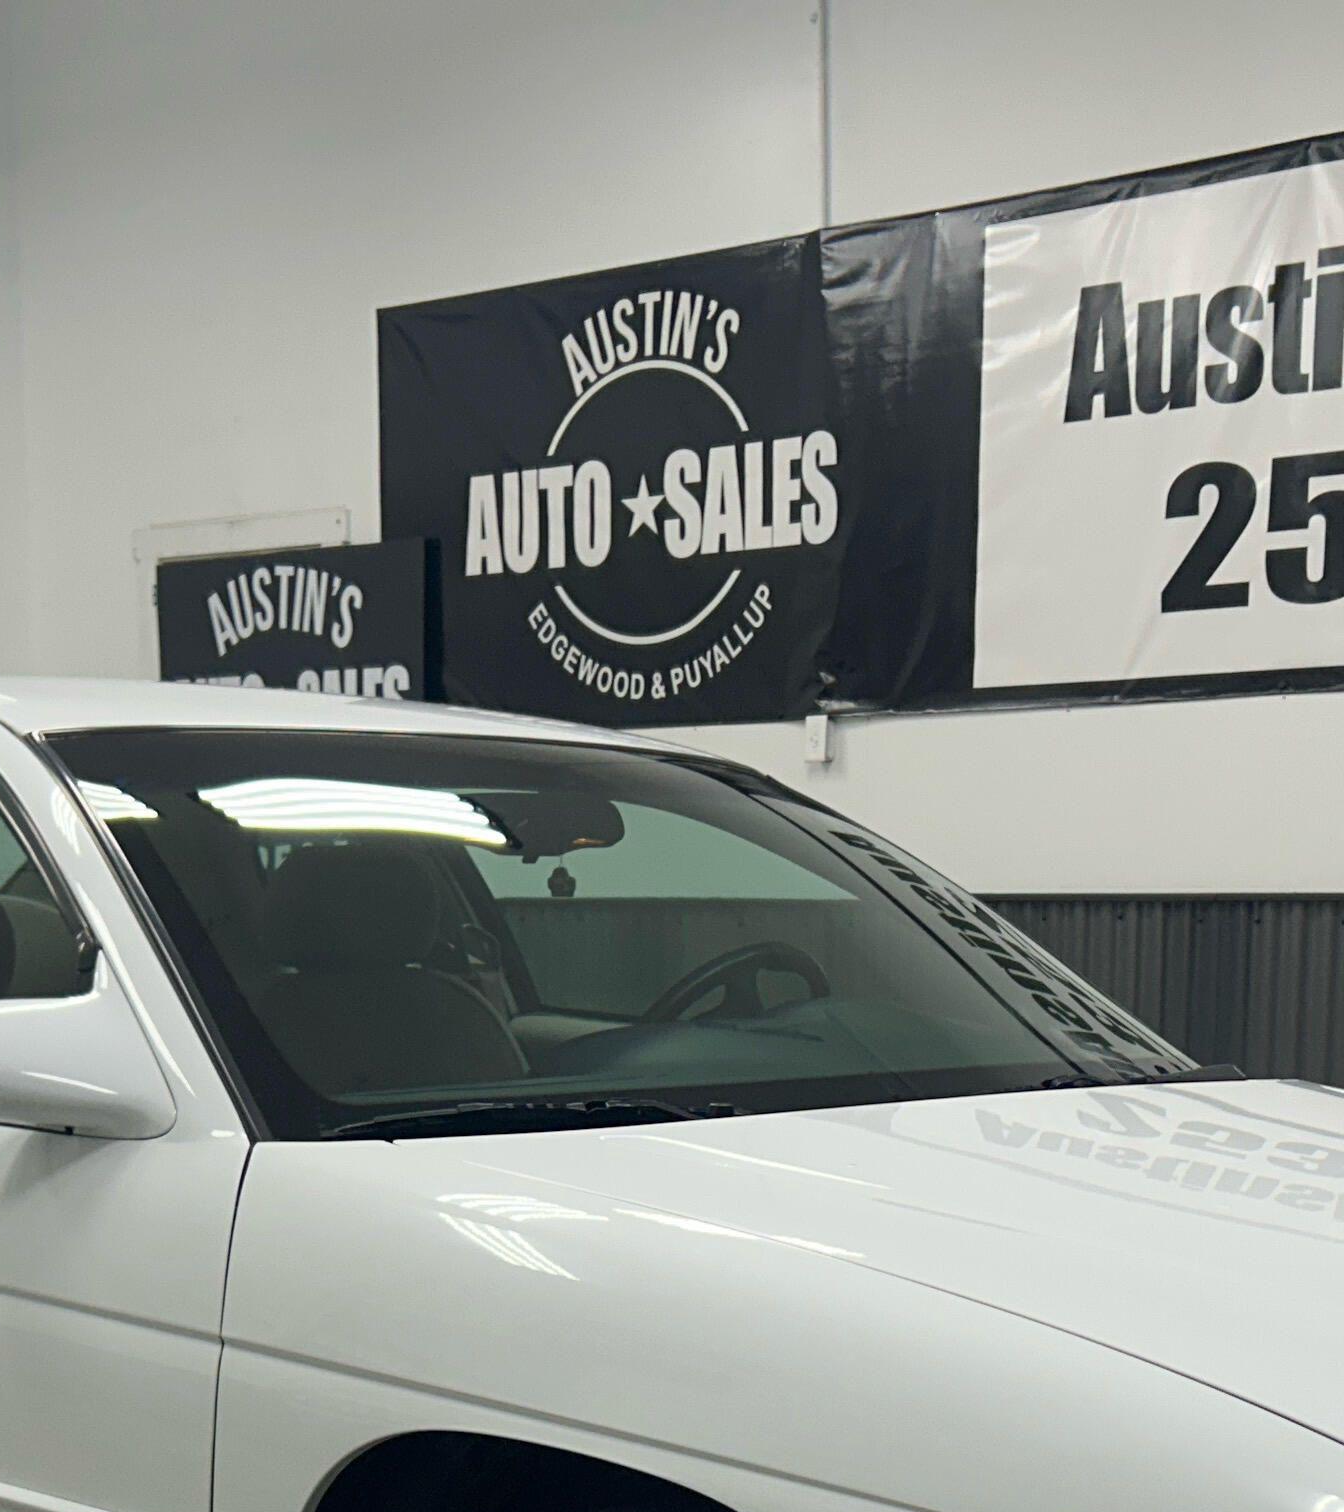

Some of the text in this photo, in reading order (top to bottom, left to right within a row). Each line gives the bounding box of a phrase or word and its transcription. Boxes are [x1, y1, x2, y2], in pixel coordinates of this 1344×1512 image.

[561, 289, 741, 397] AUSTIN'S
[465, 429, 840, 577] AUTO SALES
[206, 563, 364, 657] AUSTIN'S
[526, 582, 775, 702] EDGEWOOD & PUYALLUP
